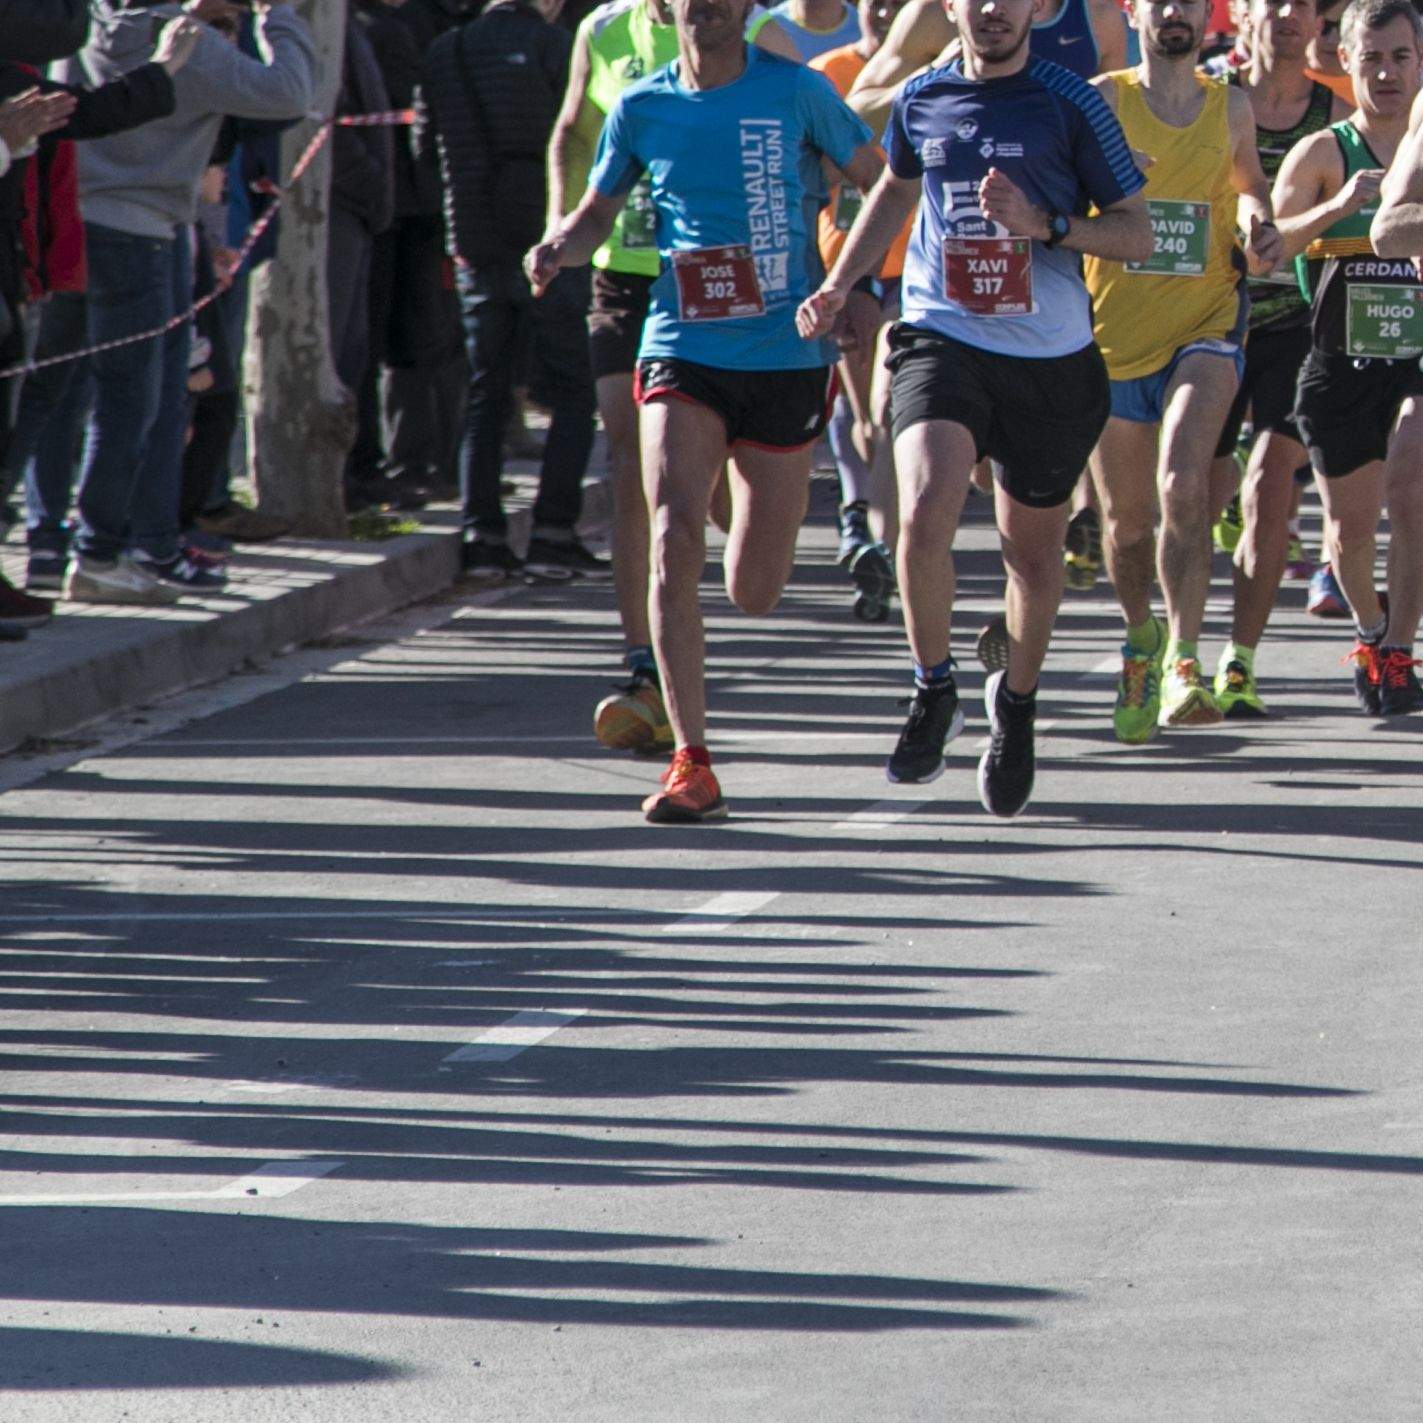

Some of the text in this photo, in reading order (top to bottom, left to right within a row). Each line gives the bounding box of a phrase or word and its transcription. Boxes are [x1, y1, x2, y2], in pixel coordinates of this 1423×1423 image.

[740, 127, 773, 251] RENAULT
[766, 129, 790, 249] STREET RUN
[956, 221, 987, 232] Sant
[1153, 236, 1188, 254] 240
[967, 259, 1008, 273] XAVI
[704, 282, 737, 299] 302
[973, 278, 1003, 295] 317
[1366, 304, 1415, 318] HUGO
[1379, 321, 1401, 337] 26
